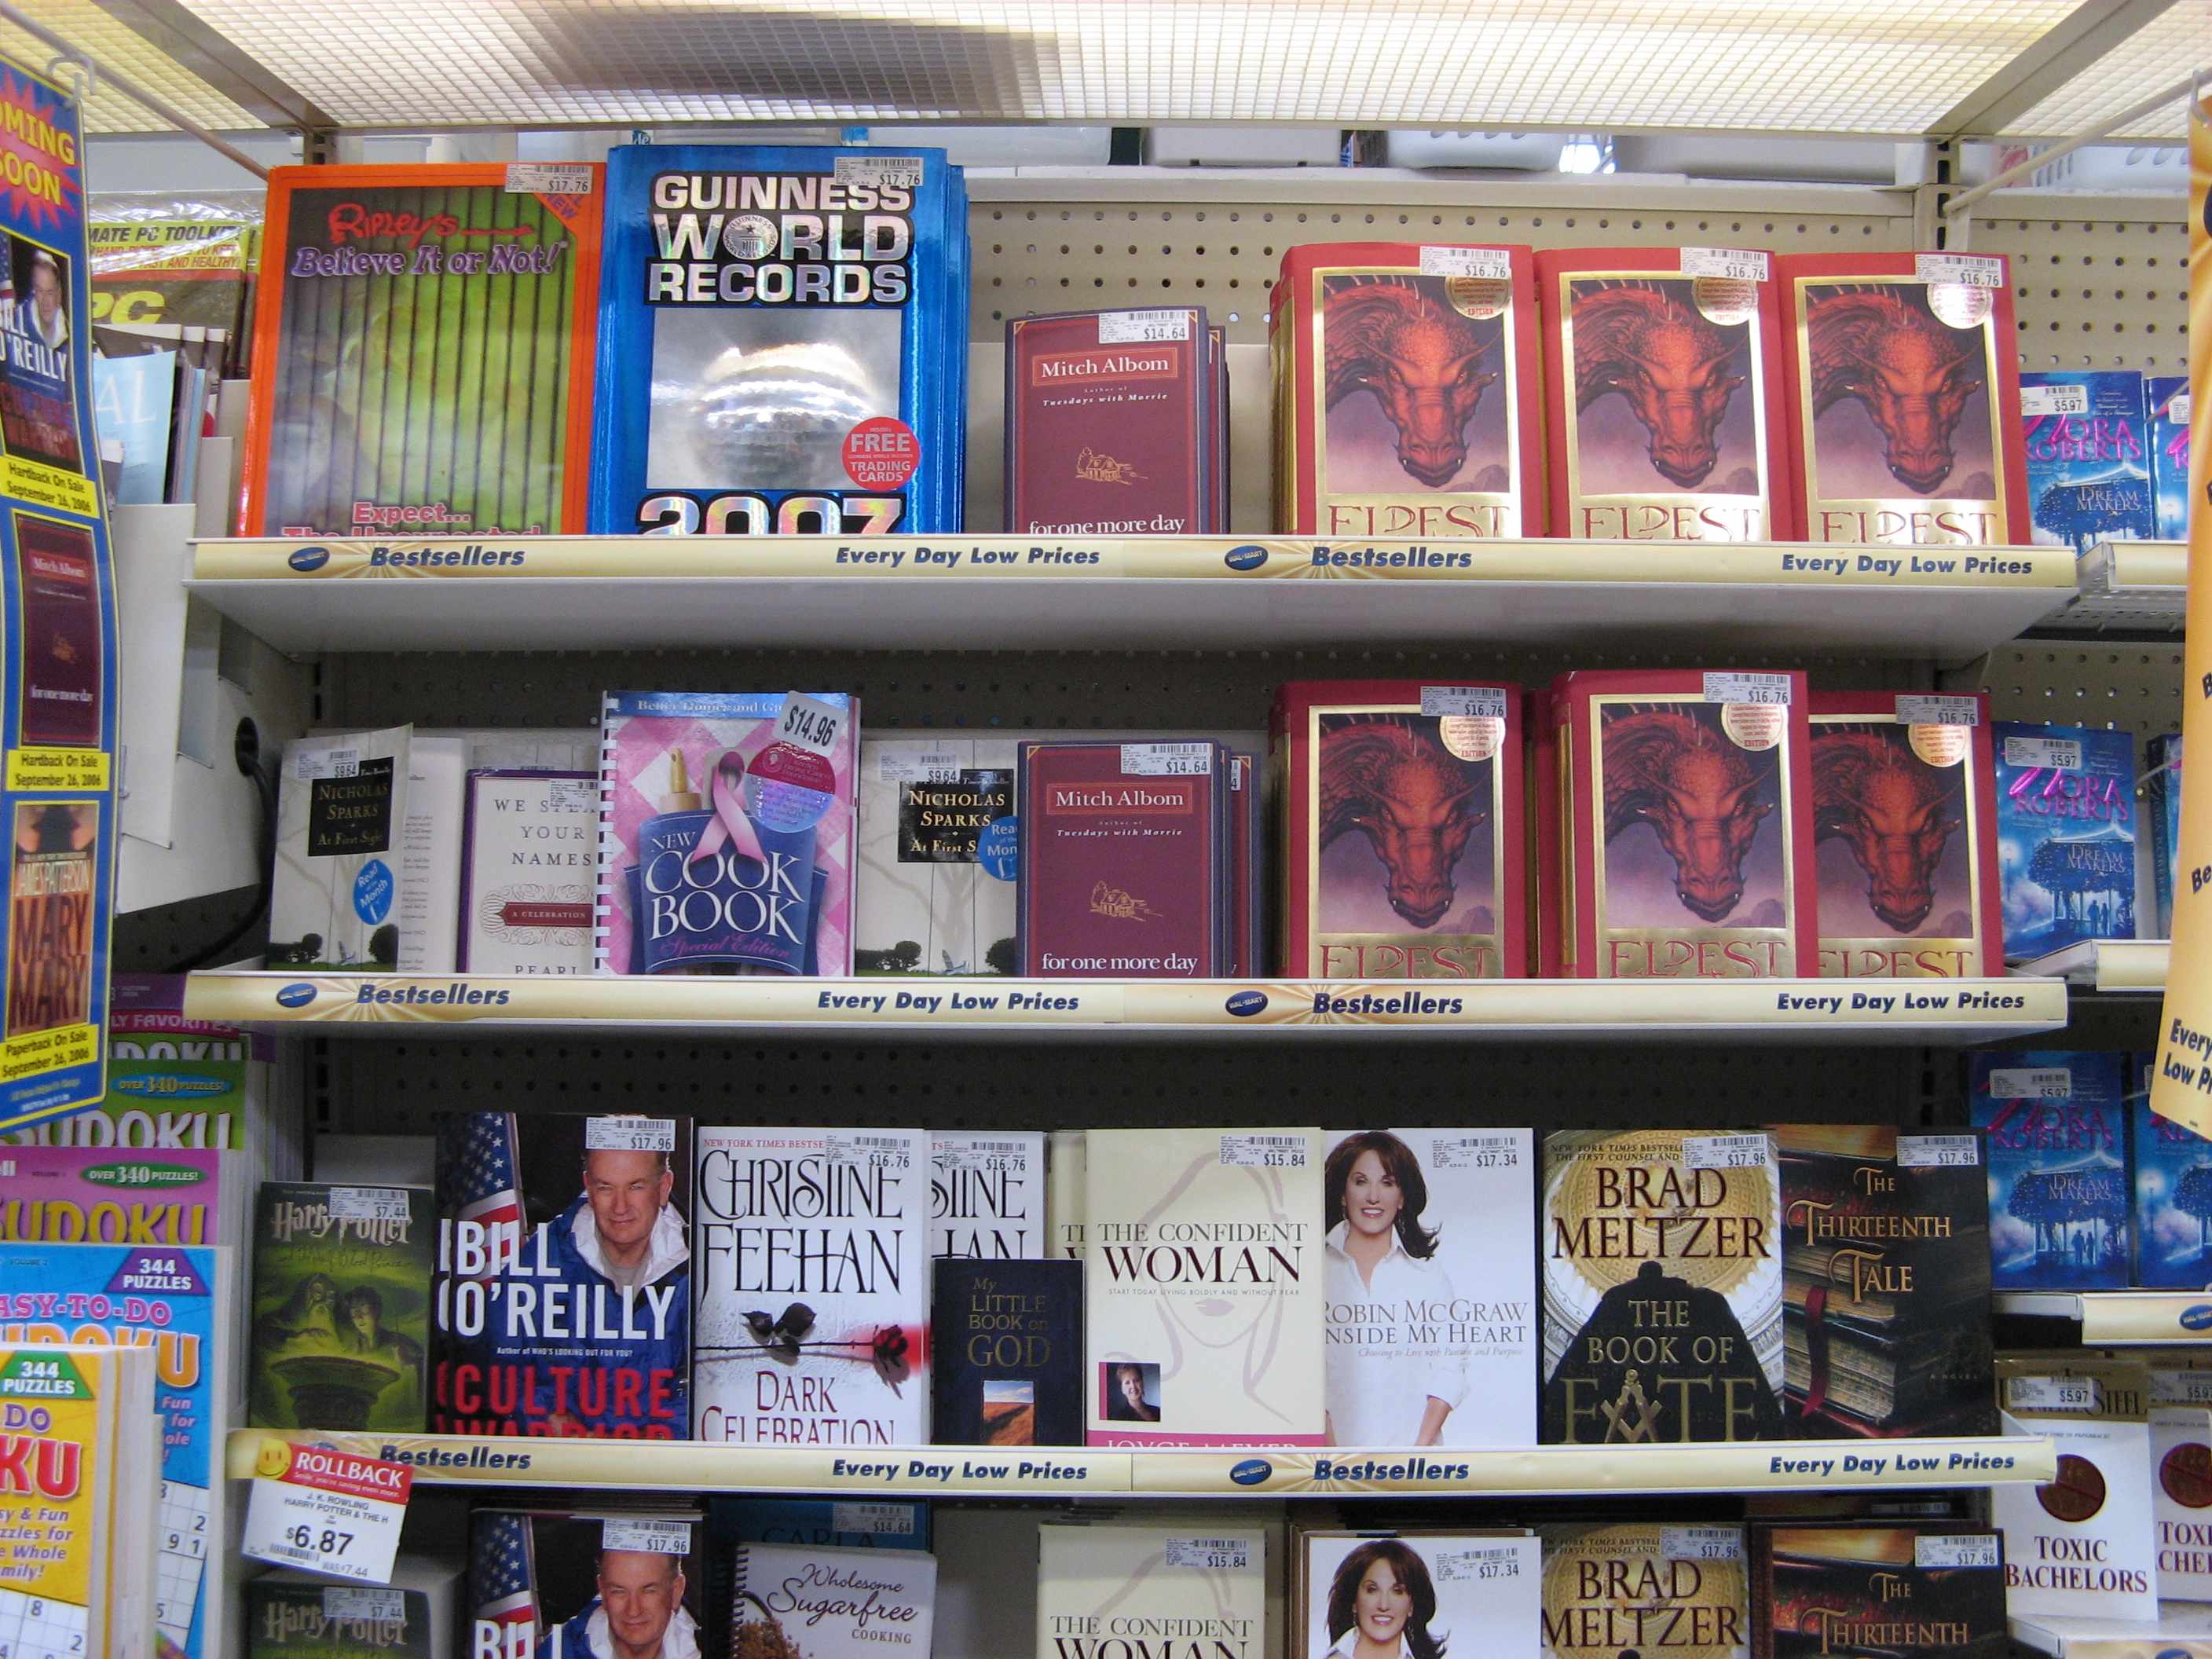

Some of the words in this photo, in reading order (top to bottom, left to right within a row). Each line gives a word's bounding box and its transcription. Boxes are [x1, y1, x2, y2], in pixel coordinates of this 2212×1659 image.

[549, 180, 588, 192] $17.76
[880, 174, 920, 185] $17.76
[654, 175, 910, 211] GUINNESS
[292, 247, 405, 276] Believe
[412, 245, 443, 274] It
[449, 251, 480, 273] or
[488, 243, 559, 274] Not!
[1466, 266, 1506, 277] $16.76
[1726, 267, 1765, 280] $16.76
[649, 263, 907, 303] RECORDS
[1144, 327, 1185, 340] $14.64
[1042, 358, 1097, 378] Mitch
[1102, 357, 1169, 374] Albom
[2055, 400, 2082, 411] $5.97
[851, 434, 910, 452] FREE
[851, 461, 911, 472] TRADING
[858, 472, 903, 482] CARDS
[640, 496, 902, 535] 2007
[371, 548, 524, 567] Bestsellers
[837, 548, 904, 567] Every
[915, 548, 961, 568] Day
[971, 548, 1019, 564] Low
[1027, 547, 1100, 564] Prices
[1311, 547, 1472, 569] Bestsellers
[1782, 555, 1849, 576] Every
[1857, 555, 1902, 577] Day
[1911, 557, 1956, 573] Low
[1965, 556, 2033, 574] Prices
[1749, 690, 1788, 704] $16.76
[1464, 704, 1503, 716] $16.76
[784, 706, 837, 746] $14.96
[21, 754, 63, 767] Hardback
[66, 755, 79, 767] On
[81, 755, 97, 767] Sale
[1166, 761, 1207, 774] $14.64
[2051, 756, 2076, 766] $5.97
[16, 774, 64, 788] September
[82, 775, 101, 786] 2006
[319, 785, 389, 800] NICHOLAS
[909, 791, 1005, 807] NICHOLAS
[1056, 791, 1112, 807] Mitch
[1119, 790, 1184, 806] Albom
[327, 804, 379, 819] SPARKS
[495, 800, 526, 811] WE
[2014, 793, 2128, 821] ROBERTS
[921, 811, 991, 827] SPARKS
[521, 826, 584, 840] YOUR
[651, 832, 696, 850] NEW
[911, 841, 926, 851] At
[932, 841, 961, 852] First
[511, 853, 591, 866] NAMES
[645, 850, 804, 902] COOK
[650, 891, 803, 945] BOOK
[1042, 953, 1071, 969] for
[1071, 958, 1107, 969] one
[1110, 957, 1159, 969] more
[1163, 953, 1199, 975] day
[357, 984, 509, 1005] Bestsellers
[818, 992, 887, 1013] Every
[895, 992, 941, 1013] Day
[951, 992, 999, 1009] Low
[1008, 992, 1079, 1010] Prices
[1313, 992, 1463, 1014] Bestsellers
[6, 1038, 52, 1057] Paperback
[54, 1035, 67, 1046] On
[70, 1031, 88, 1043] Sale
[631, 1138, 672, 1150] $17.96
[869, 1156, 910, 1168] $16.76
[986, 1159, 1026, 1171] $16.76
[1263, 1154, 1305, 1166] $15.84
[1477, 1154, 1518, 1167] $17.34
[1727, 1152, 1766, 1166] $17.96
[1938, 1151, 1976, 1164] $17.96
[89, 1170, 115, 1180] OVER
[117, 1166, 150, 1184] 340
[152, 1170, 198, 1181] PUZZLES!
[2053, 1175, 2110, 1191] DREAM
[700, 1149, 903, 1222] CHRISTINE
[1596, 1166, 1726, 1209] BRAD
[2049, 1188, 2112, 1201] MAKERS
[376, 1207, 406, 1218] $7.44
[1097, 1223, 1149, 1241] THE
[1159, 1222, 1308, 1242] CONFIDENT
[1552, 1215, 1771, 1260] MELTZER
[456, 1221, 562, 1276] BILL
[139, 1259, 176, 1274] 344
[701, 1223, 903, 1305] FEEHAN
[1103, 1246, 1302, 1284] WOMAN
[123, 1275, 192, 1290] PUZZLES
[973, 1278, 996, 1294] My
[456, 1285, 675, 1340] O'REILLY
[972, 1295, 1045, 1312] LITTLE
[969, 1314, 1022, 1329] BOOK
[1028, 1319, 1049, 1331] on
[1629, 1300, 1690, 1328] THE
[1408, 1325, 1441, 1342] MY
[1448, 1324, 1527, 1342] HEART
[967, 1335, 1050, 1367] GOD
[1587, 1336, 1679, 1364] BOOK
[1693, 1335, 1734, 1363] OF
[20, 1361, 59, 1378] 344
[2, 1379, 75, 1394] PUZZLES
[456, 1365, 675, 1419] CULTURE
[756, 1371, 837, 1413] DARK
[2060, 1390, 2088, 1402] $5.97
[380, 1445, 531, 1469] Bestsellers
[1770, 1456, 1834, 1476] Every
[1843, 1456, 1886, 1474] Day
[1896, 1454, 1941, 1470] Low
[1948, 1452, 2015, 1470] Prices
[295, 1452, 404, 1489] ROLLBACK
[833, 1459, 899, 1479] Every
[909, 1460, 953, 1479] Day
[963, 1461, 1009, 1476] Low
[1018, 1460, 1086, 1478] Prices
[1313, 1458, 1468, 1481] Bestsellers
[284, 1498, 314, 1510] HARRY
[317, 1502, 353, 1517] POTTER
[362, 1511, 379, 1522] THE
[327, 1494, 370, 1511] ROWLING
[874, 1521, 911, 1533] $14.64
[286, 1525, 354, 1556] $6.87
[2034, 1536, 2108, 1562] TOXIC
[13, 1546, 66, 1560] Whole
[802, 1562, 904, 1594] Wholesome
[2004, 1563, 2148, 1593] BACHELORS
[767, 1578, 917, 1626] Sugarfree
[852, 1630, 911, 1643] COOKING
